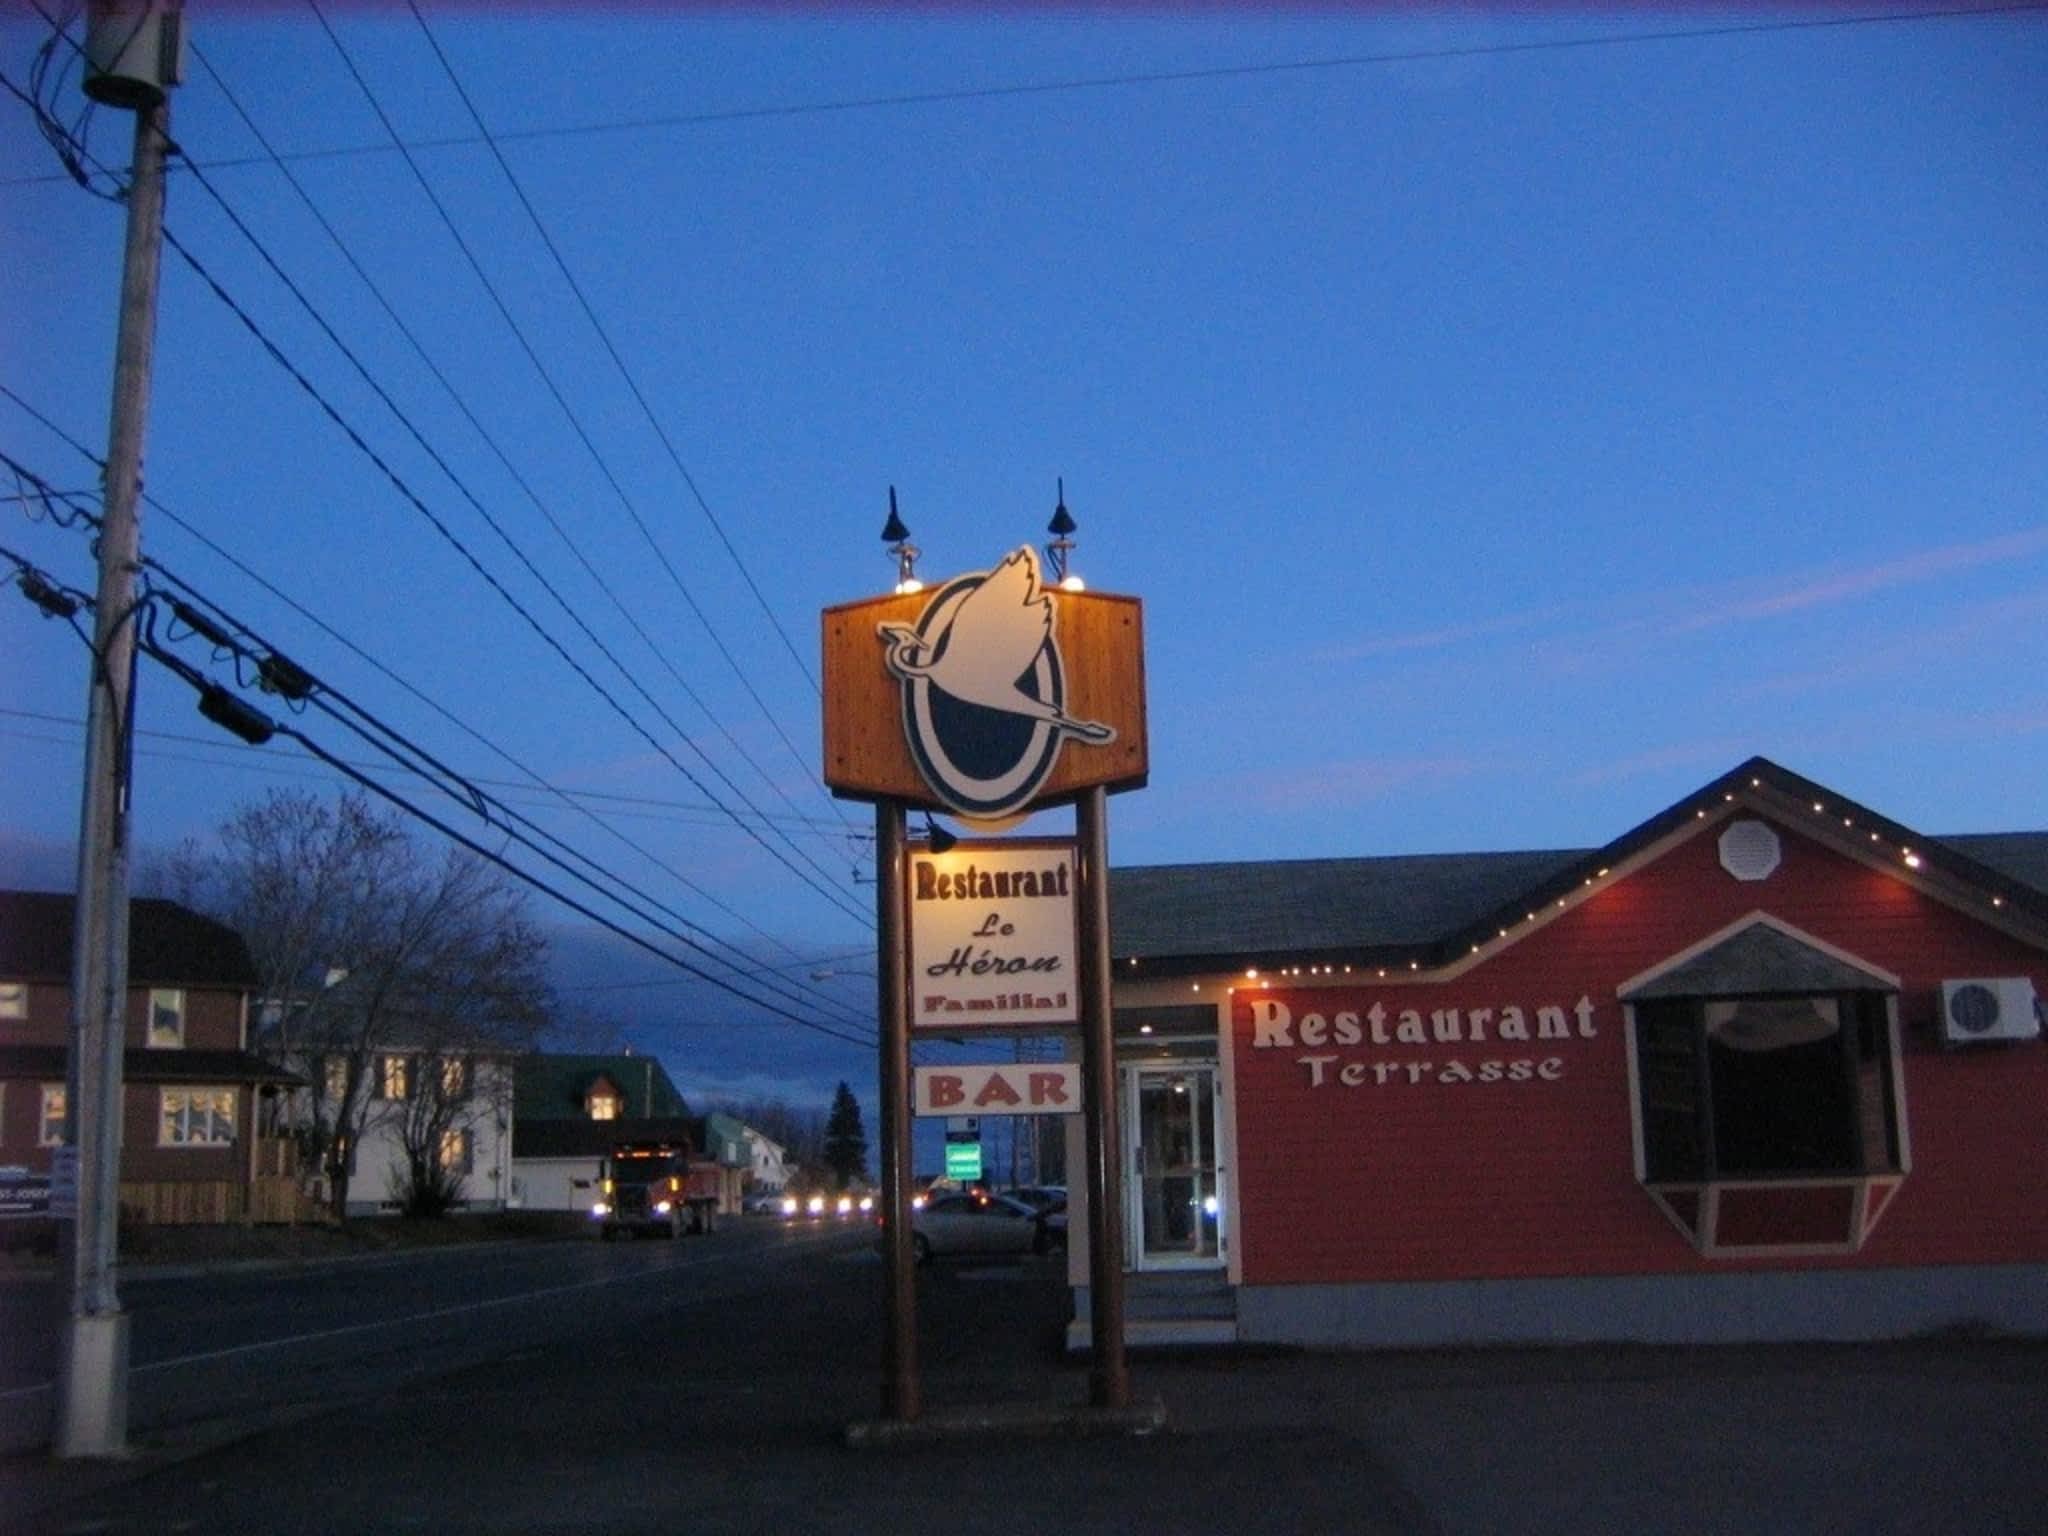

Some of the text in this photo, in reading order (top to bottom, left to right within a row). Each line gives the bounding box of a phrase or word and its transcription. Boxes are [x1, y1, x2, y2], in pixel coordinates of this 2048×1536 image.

[916, 861, 1068, 900] Restaurant
[972, 914, 1015, 937] Le
[927, 945, 1061, 976] Héron
[924, 993, 1067, 1012] Familial
[1251, 995, 1598, 1047] Restaurant
[1298, 1055, 1564, 1087] Terrasse
[929, 1073, 1068, 1107] BAR
